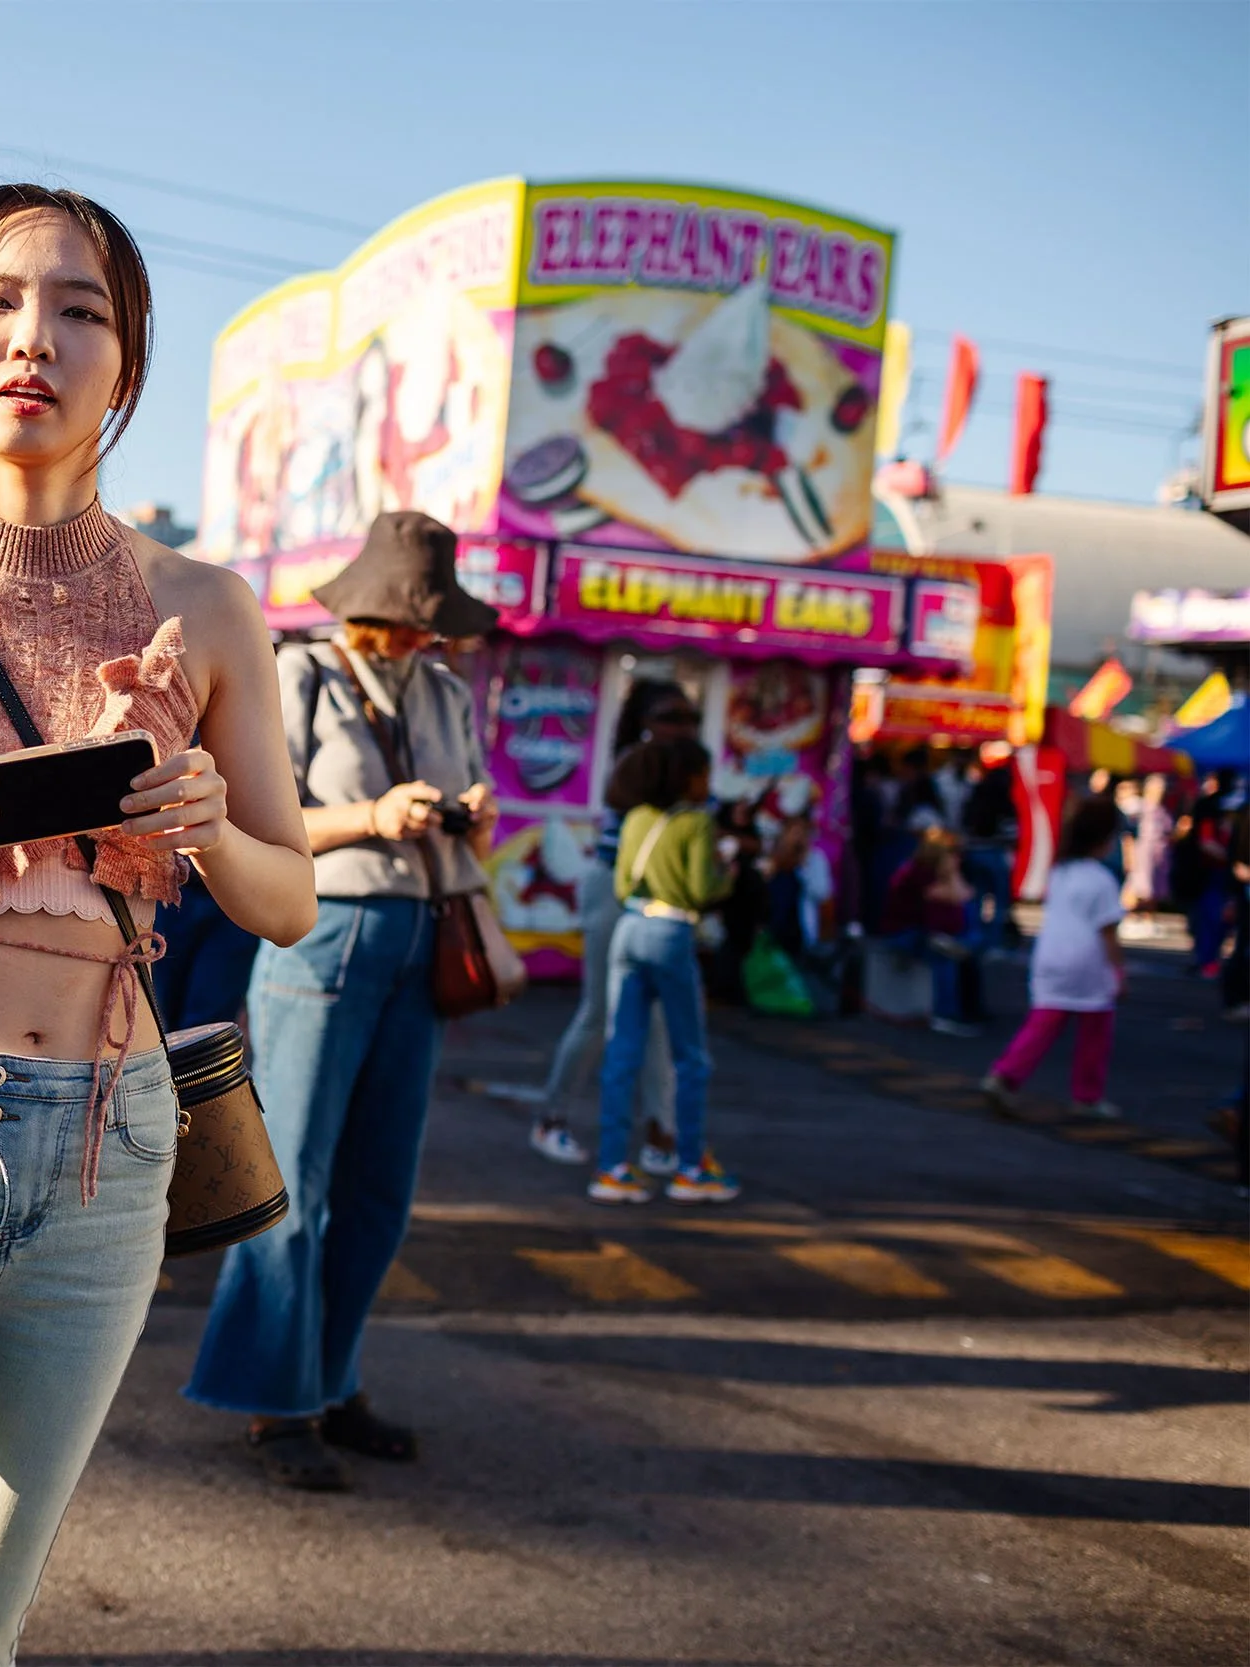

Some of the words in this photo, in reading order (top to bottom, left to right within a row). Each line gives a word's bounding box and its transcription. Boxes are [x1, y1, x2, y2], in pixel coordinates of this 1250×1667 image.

[533, 203, 762, 284] ELEPHANT
[770, 220, 881, 318] EARS
[579, 561, 769, 623] ELEPHANT
[773, 578, 873, 637] EARS
